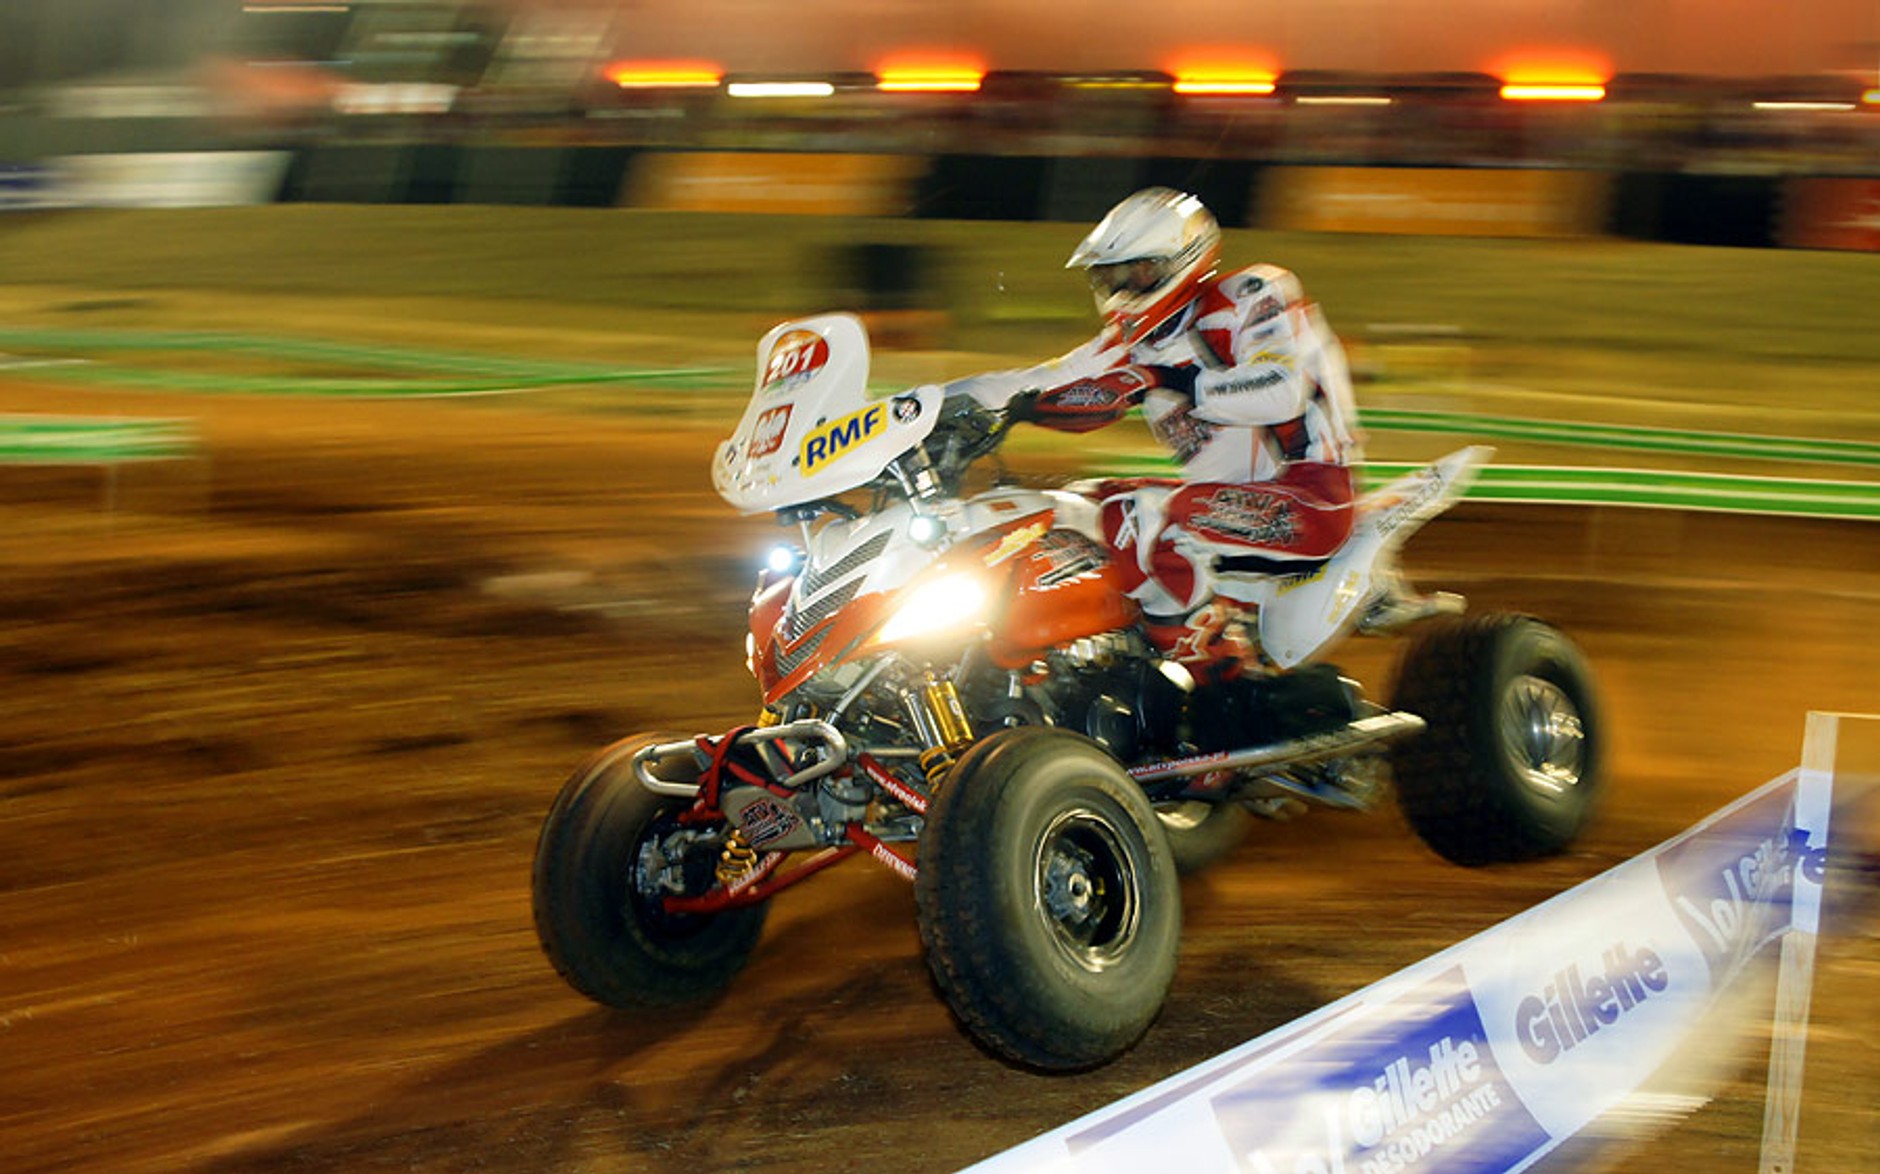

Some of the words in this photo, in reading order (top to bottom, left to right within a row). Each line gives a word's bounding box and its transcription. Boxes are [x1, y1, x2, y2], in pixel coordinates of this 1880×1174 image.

[766, 341, 817, 384] 201
[805, 406, 881, 468] RMF
[1515, 940, 1669, 1065] Gillette
[1350, 1035, 1482, 1148] Gillette
